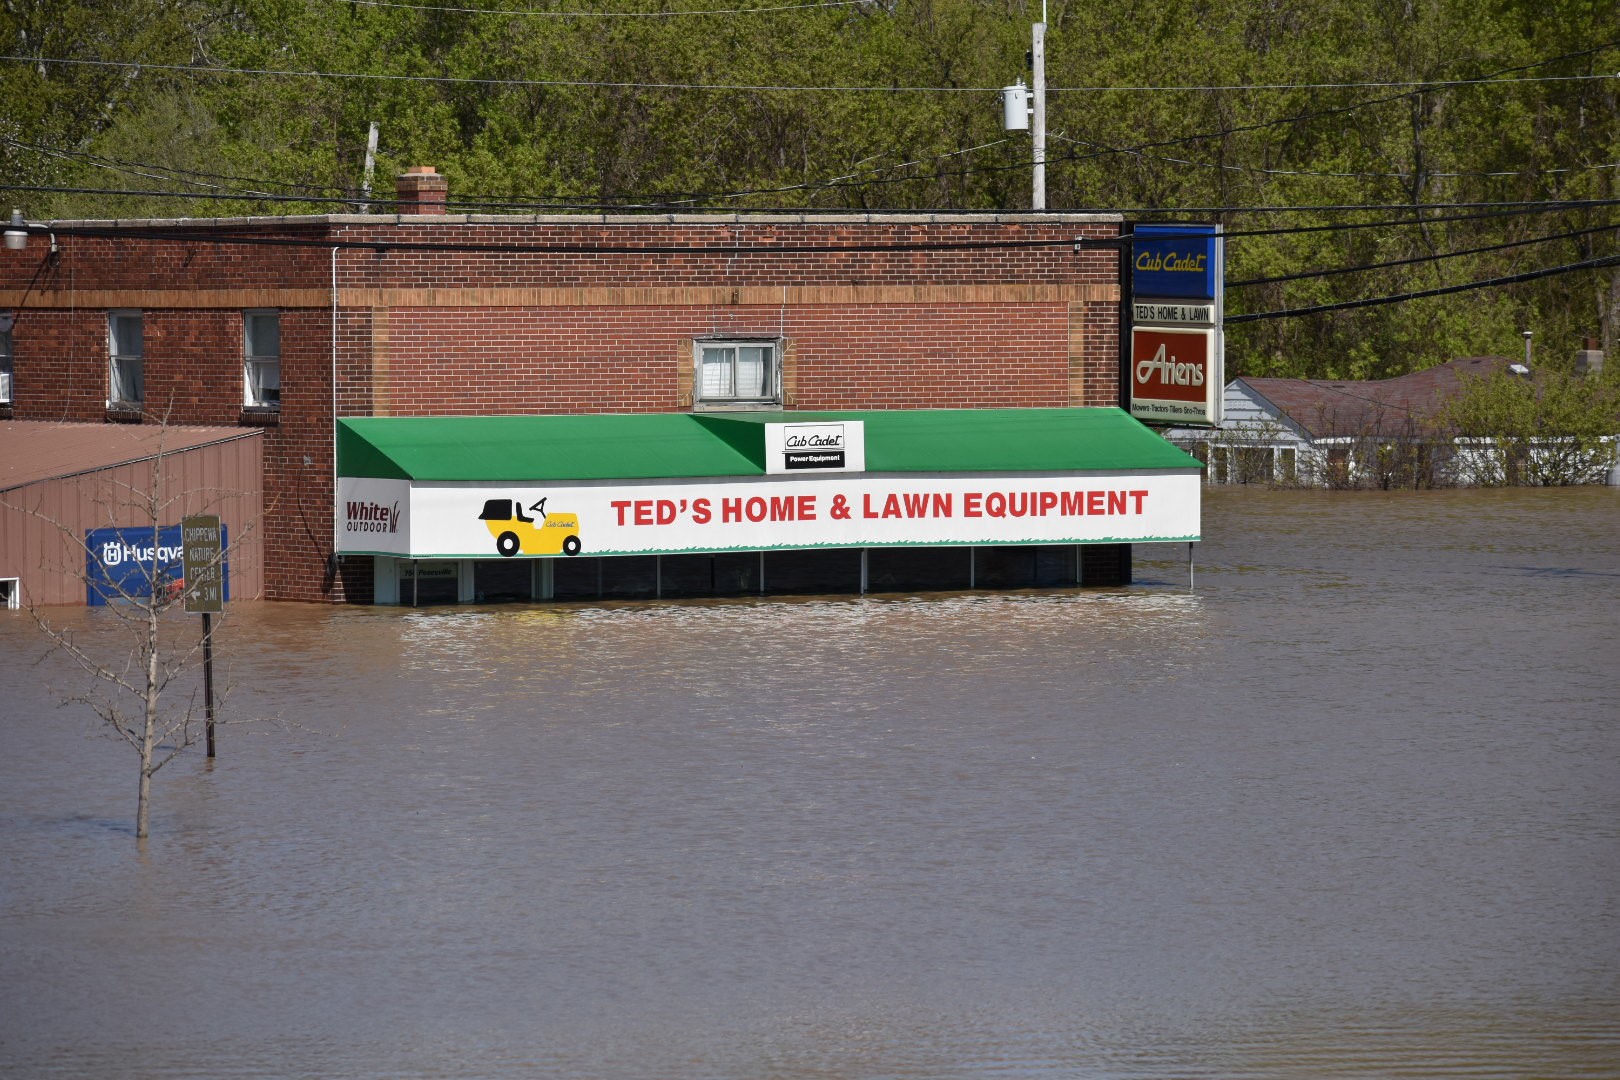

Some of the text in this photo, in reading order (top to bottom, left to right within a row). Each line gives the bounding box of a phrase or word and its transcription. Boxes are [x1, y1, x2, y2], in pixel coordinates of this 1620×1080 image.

[1135, 251, 1206, 272] Cub Cadet
[1135, 305, 1209, 321] TED'S HOME & LAWN
[1135, 343, 1204, 387] Ariens
[786, 434, 842, 447] Cub Cadet
[789, 454, 840, 463] Power Equipment
[346, 501, 390, 521] White
[610, 489, 1149, 527] TED'S HOME & LAWN EQUIPMENT
[346, 520, 387, 533] OUTDOOR
[184, 527, 217, 543] CHIPPEWA
[123, 545, 184, 563] Husqva
[189, 547, 215, 561] NATURE
[204, 586, 217, 602] 3 MI
